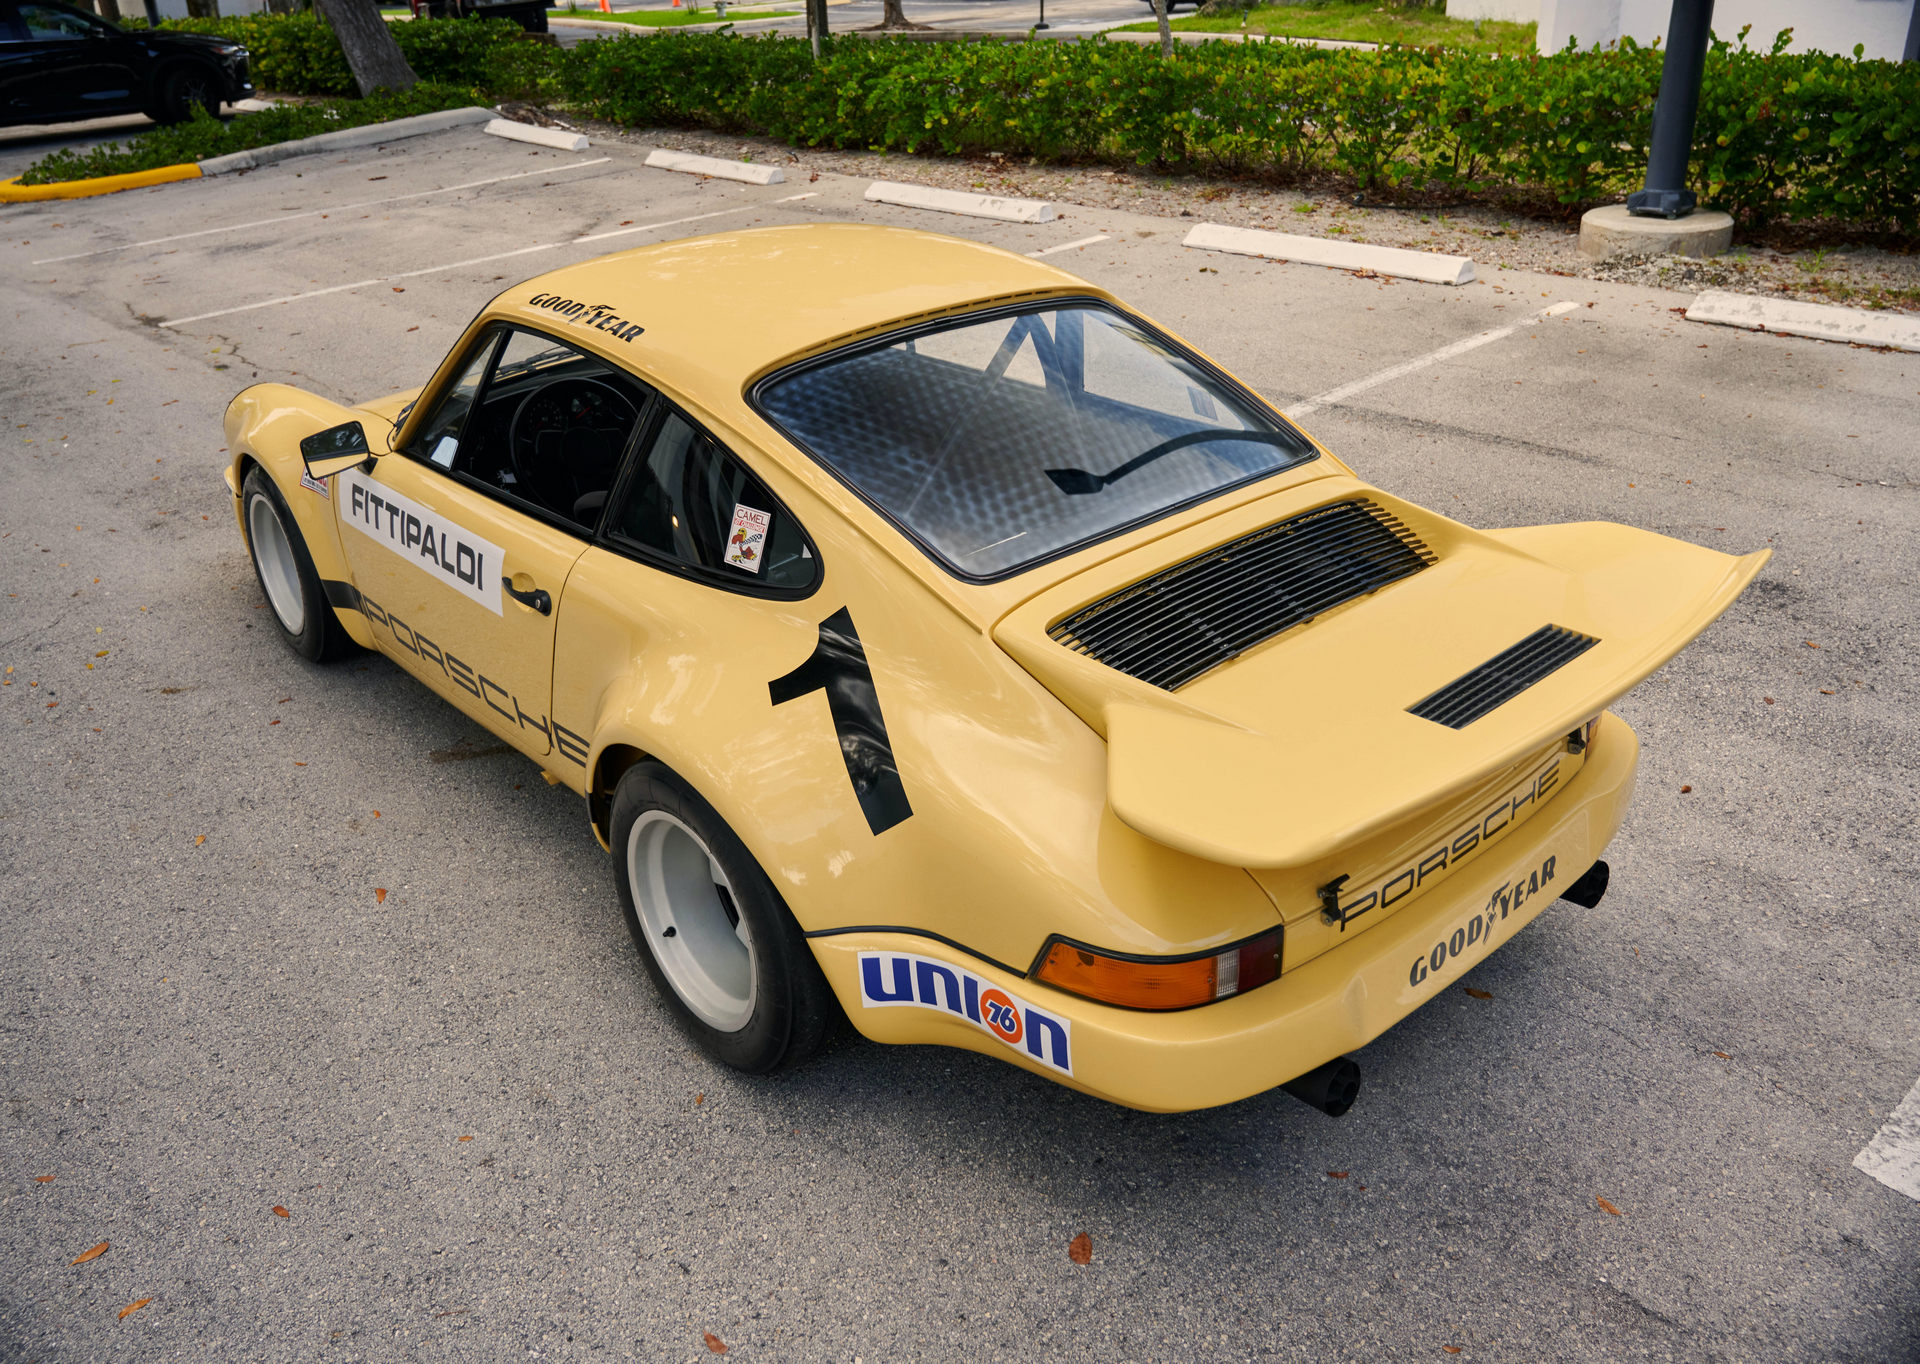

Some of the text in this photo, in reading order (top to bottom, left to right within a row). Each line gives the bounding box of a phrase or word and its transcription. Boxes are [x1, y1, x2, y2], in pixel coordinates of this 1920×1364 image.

[529, 293, 645, 343] GOODYEAR
[352, 483, 484, 591] FITTIPALDI
[736, 509, 766, 526] CAMEL
[362, 594, 590, 768] PORSCHE
[768, 605, 914, 836] 1
[1340, 760, 1560, 932] PORSCHE
[1410, 855, 1556, 987] GOODYEAR
[986, 1000, 1017, 1033] 76
